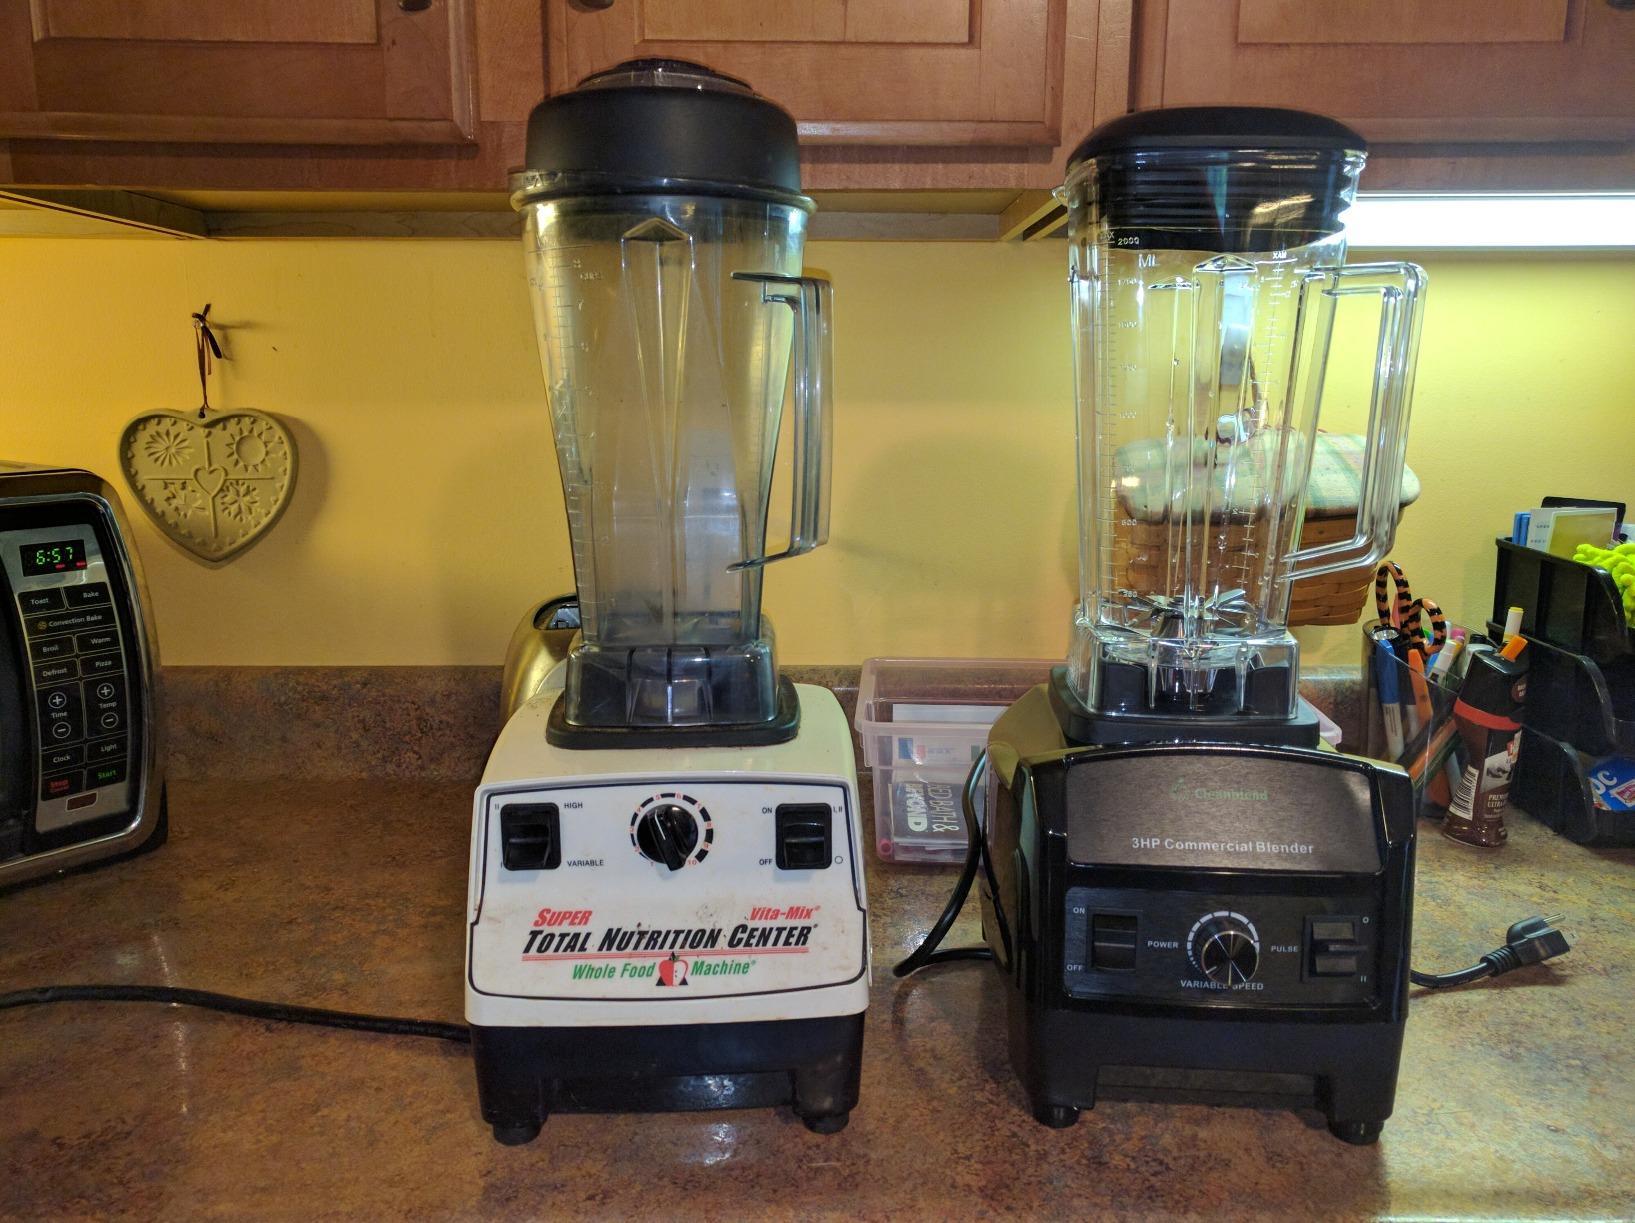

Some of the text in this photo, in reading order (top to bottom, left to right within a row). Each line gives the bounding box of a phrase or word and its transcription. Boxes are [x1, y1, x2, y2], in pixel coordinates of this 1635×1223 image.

[1117, 236, 1140, 246] 2000
[36, 546, 73, 565] 6:57
[83, 591, 99, 599] Bake
[31, 597, 49, 606] Toast
[48, 614, 103, 628] Convection Bake
[42, 644, 59, 653] Broil
[42, 667, 68, 677] Defrost
[98, 701, 117, 710] Temp
[51, 711, 68, 720] Time
[100, 743, 117, 753] Light
[53, 754, 71, 764] Clock
[98, 769, 117, 780] Start
[929, 799, 958, 823] BATH
[931, 823, 960, 832] &
[1131, 837, 1314, 854] 3HP Commercial Blender
[566, 859, 604, 868] VARIABLE
[758, 858, 773, 866] OFF
[1072, 906, 1086, 915] ON
[533, 907, 593, 928] SUPER
[522, 923, 812, 954] TOTAL NUTRITION CENTER
[1147, 940, 1179, 949] POWER
[1270, 945, 1299, 953] PULSE
[572, 959, 751, 980] Whole Food Machine
[1066, 964, 1083, 972] OFF
[1180, 979, 1264, 991] VARIABLE SPEED
